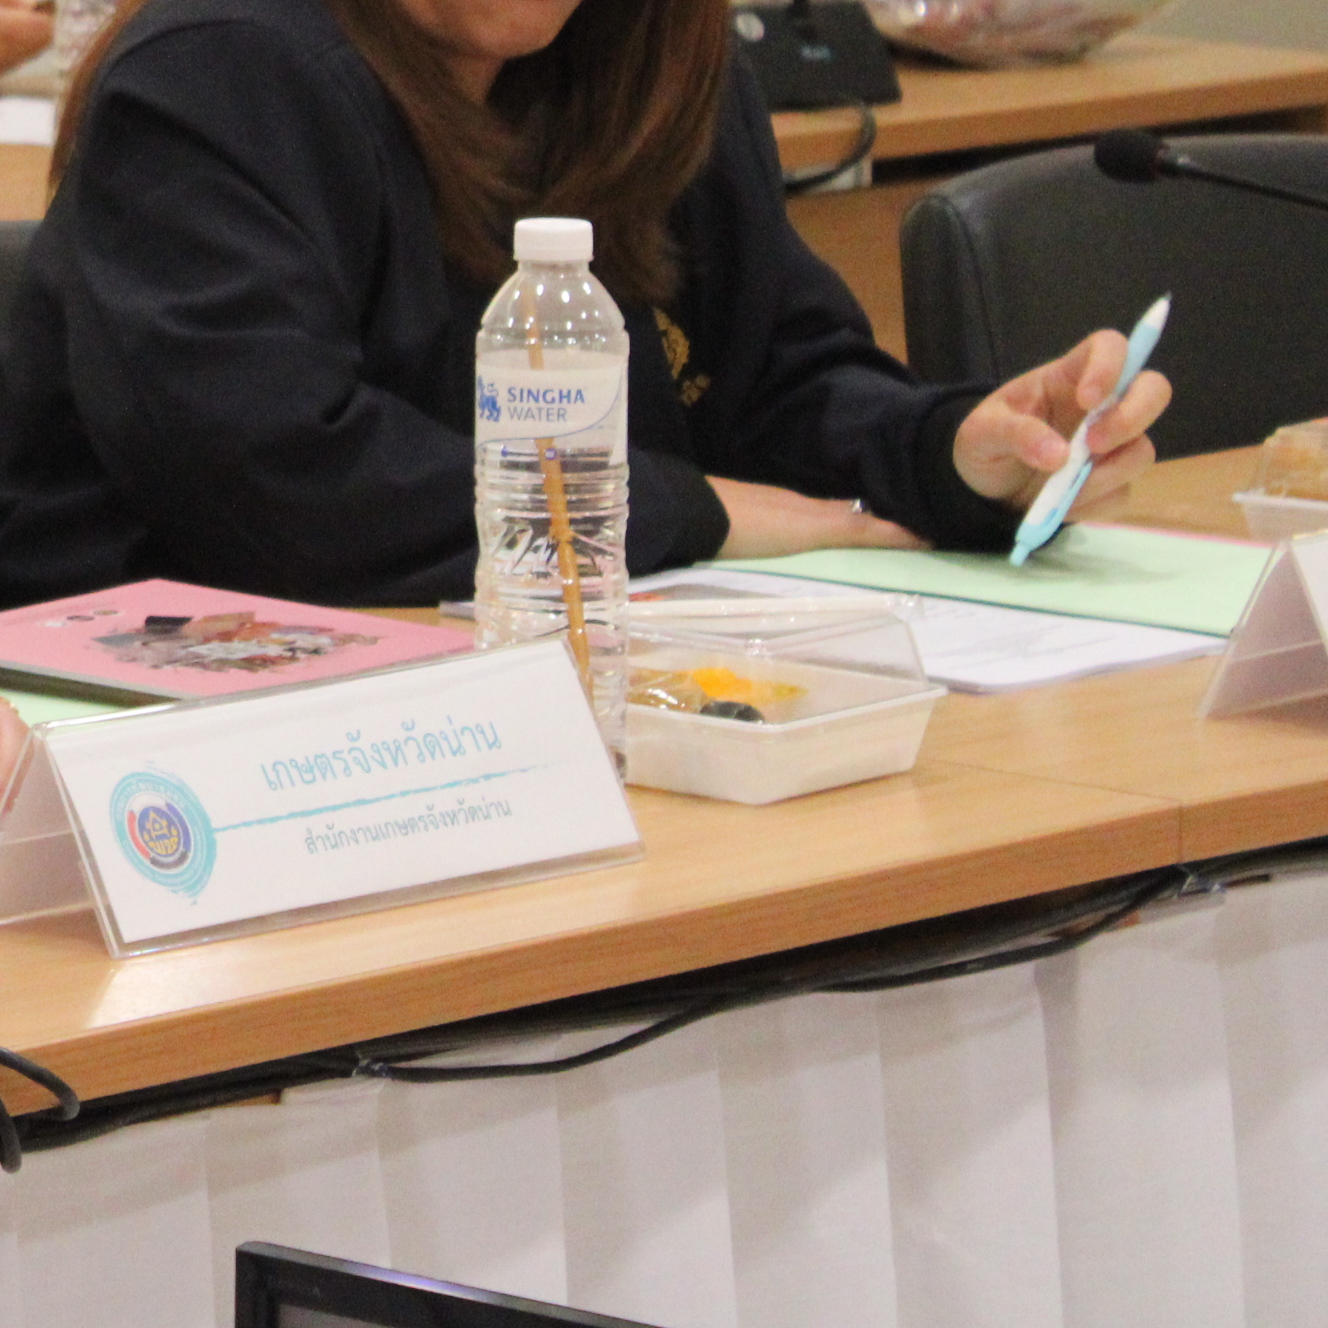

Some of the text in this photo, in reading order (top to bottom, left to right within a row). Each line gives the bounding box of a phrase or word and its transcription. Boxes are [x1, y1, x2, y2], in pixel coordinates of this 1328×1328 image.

[507, 387, 585, 404] SINGHA
[507, 406, 567, 422] WATER
[260, 716, 502, 791] เกษตรจังหวัดน่าน
[305, 797, 512, 854] สำนักงานเกษตรจังหวัดน่าน
